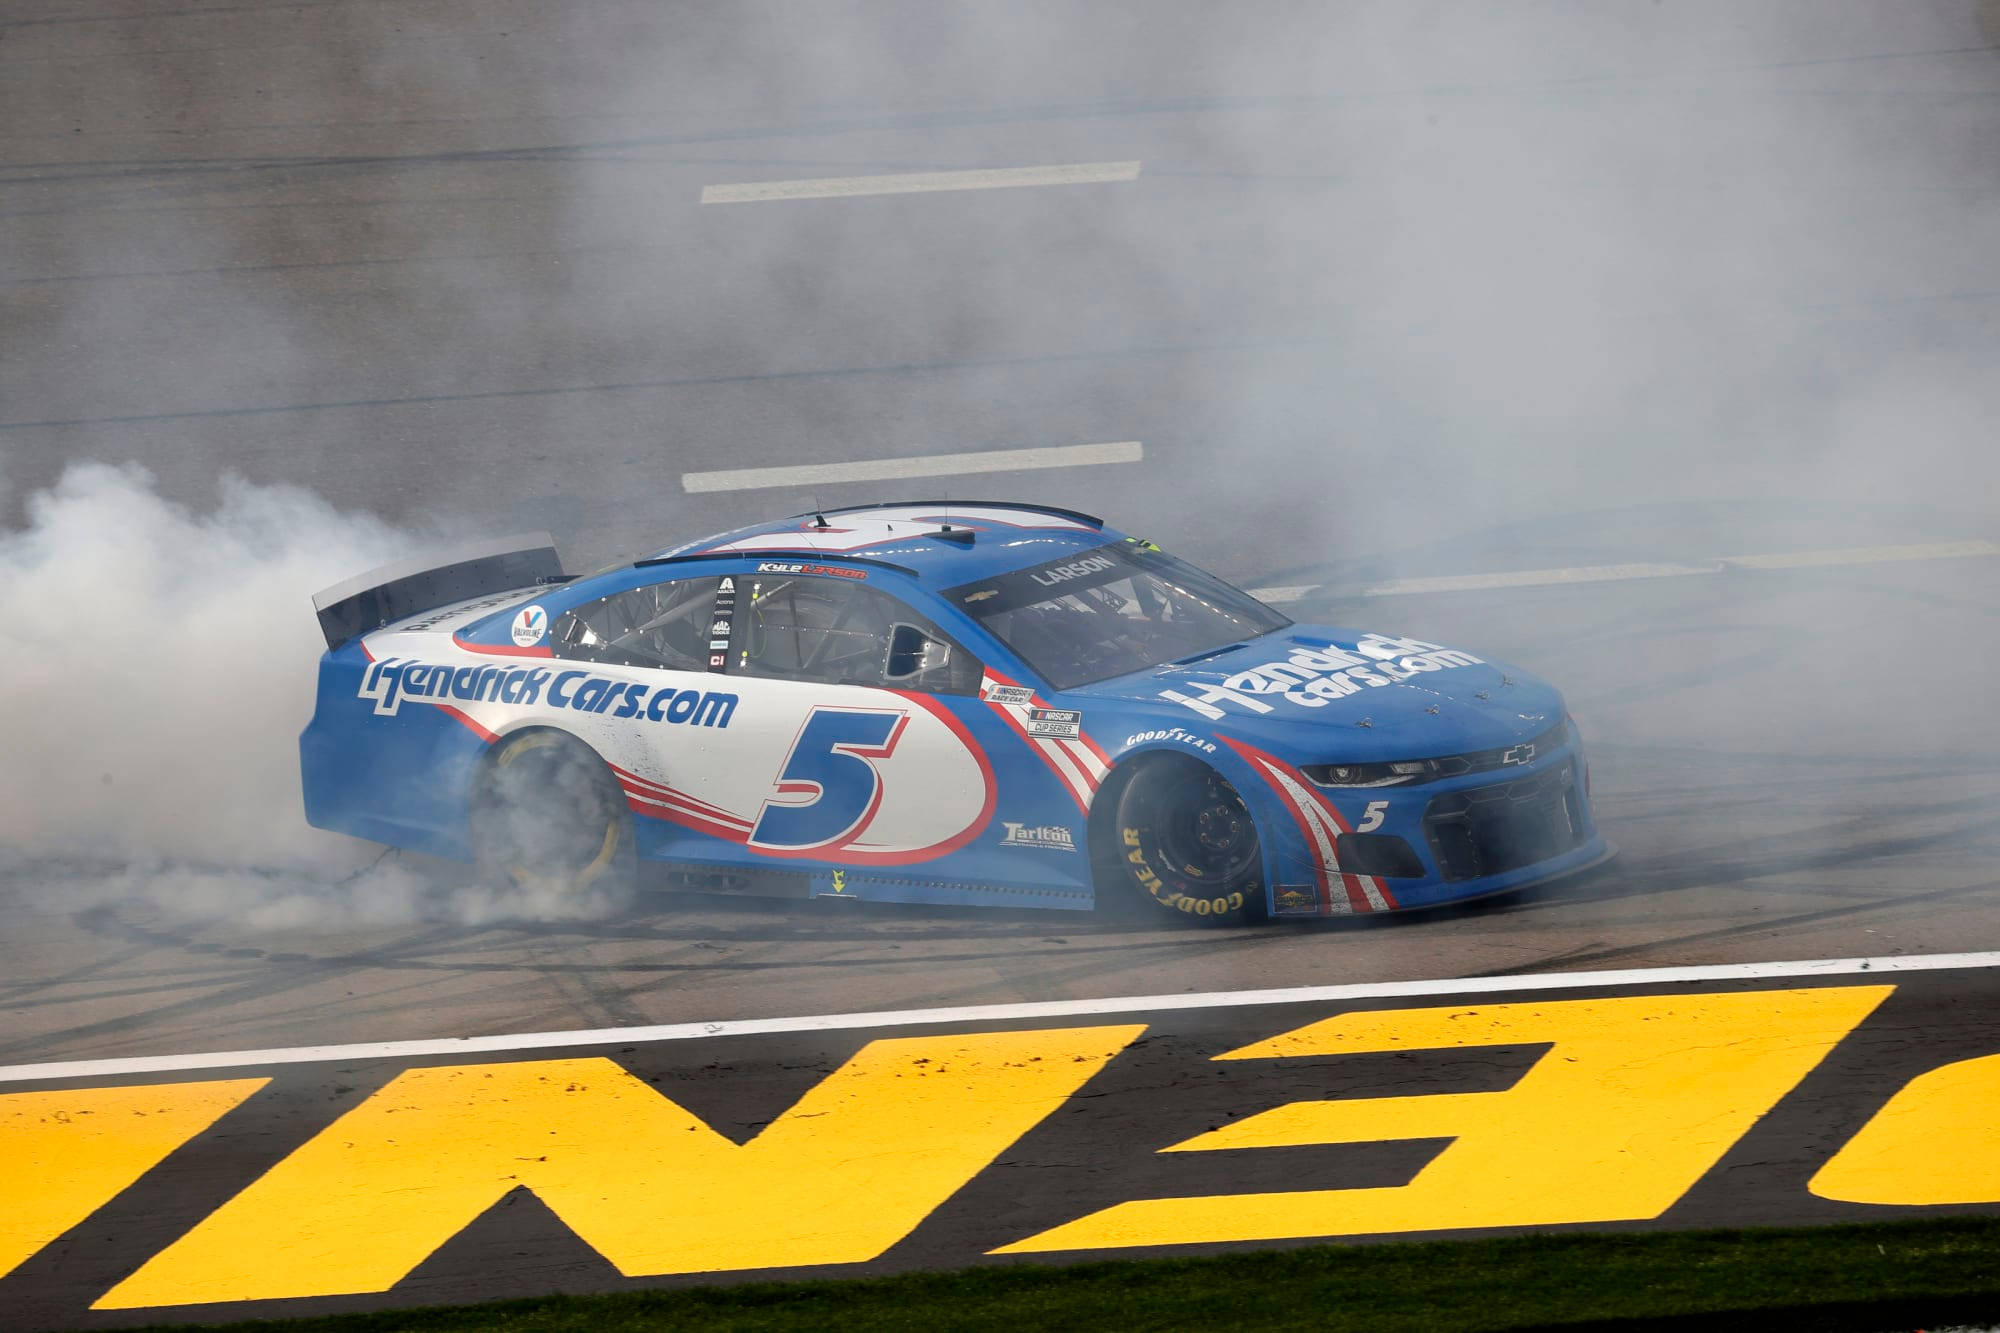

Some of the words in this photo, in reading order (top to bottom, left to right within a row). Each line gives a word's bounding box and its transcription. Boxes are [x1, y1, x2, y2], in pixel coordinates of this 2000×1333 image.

[1030, 556, 1117, 586] LARSON
[1158, 632, 1447, 720] Hendrick
[991, 694, 1008, 702] RACE
[1035, 723, 1048, 732] CUP
[1048, 724, 1073, 733] SERIES
[1045, 711, 1074, 721] NASCAR
[1126, 727, 1217, 754] GOODYEAR
[748, 705, 909, 850] 5
[1355, 800, 1390, 834] 5
[1001, 822, 1073, 843] Tarlton
[1123, 827, 1244, 916] GOODYEAR
